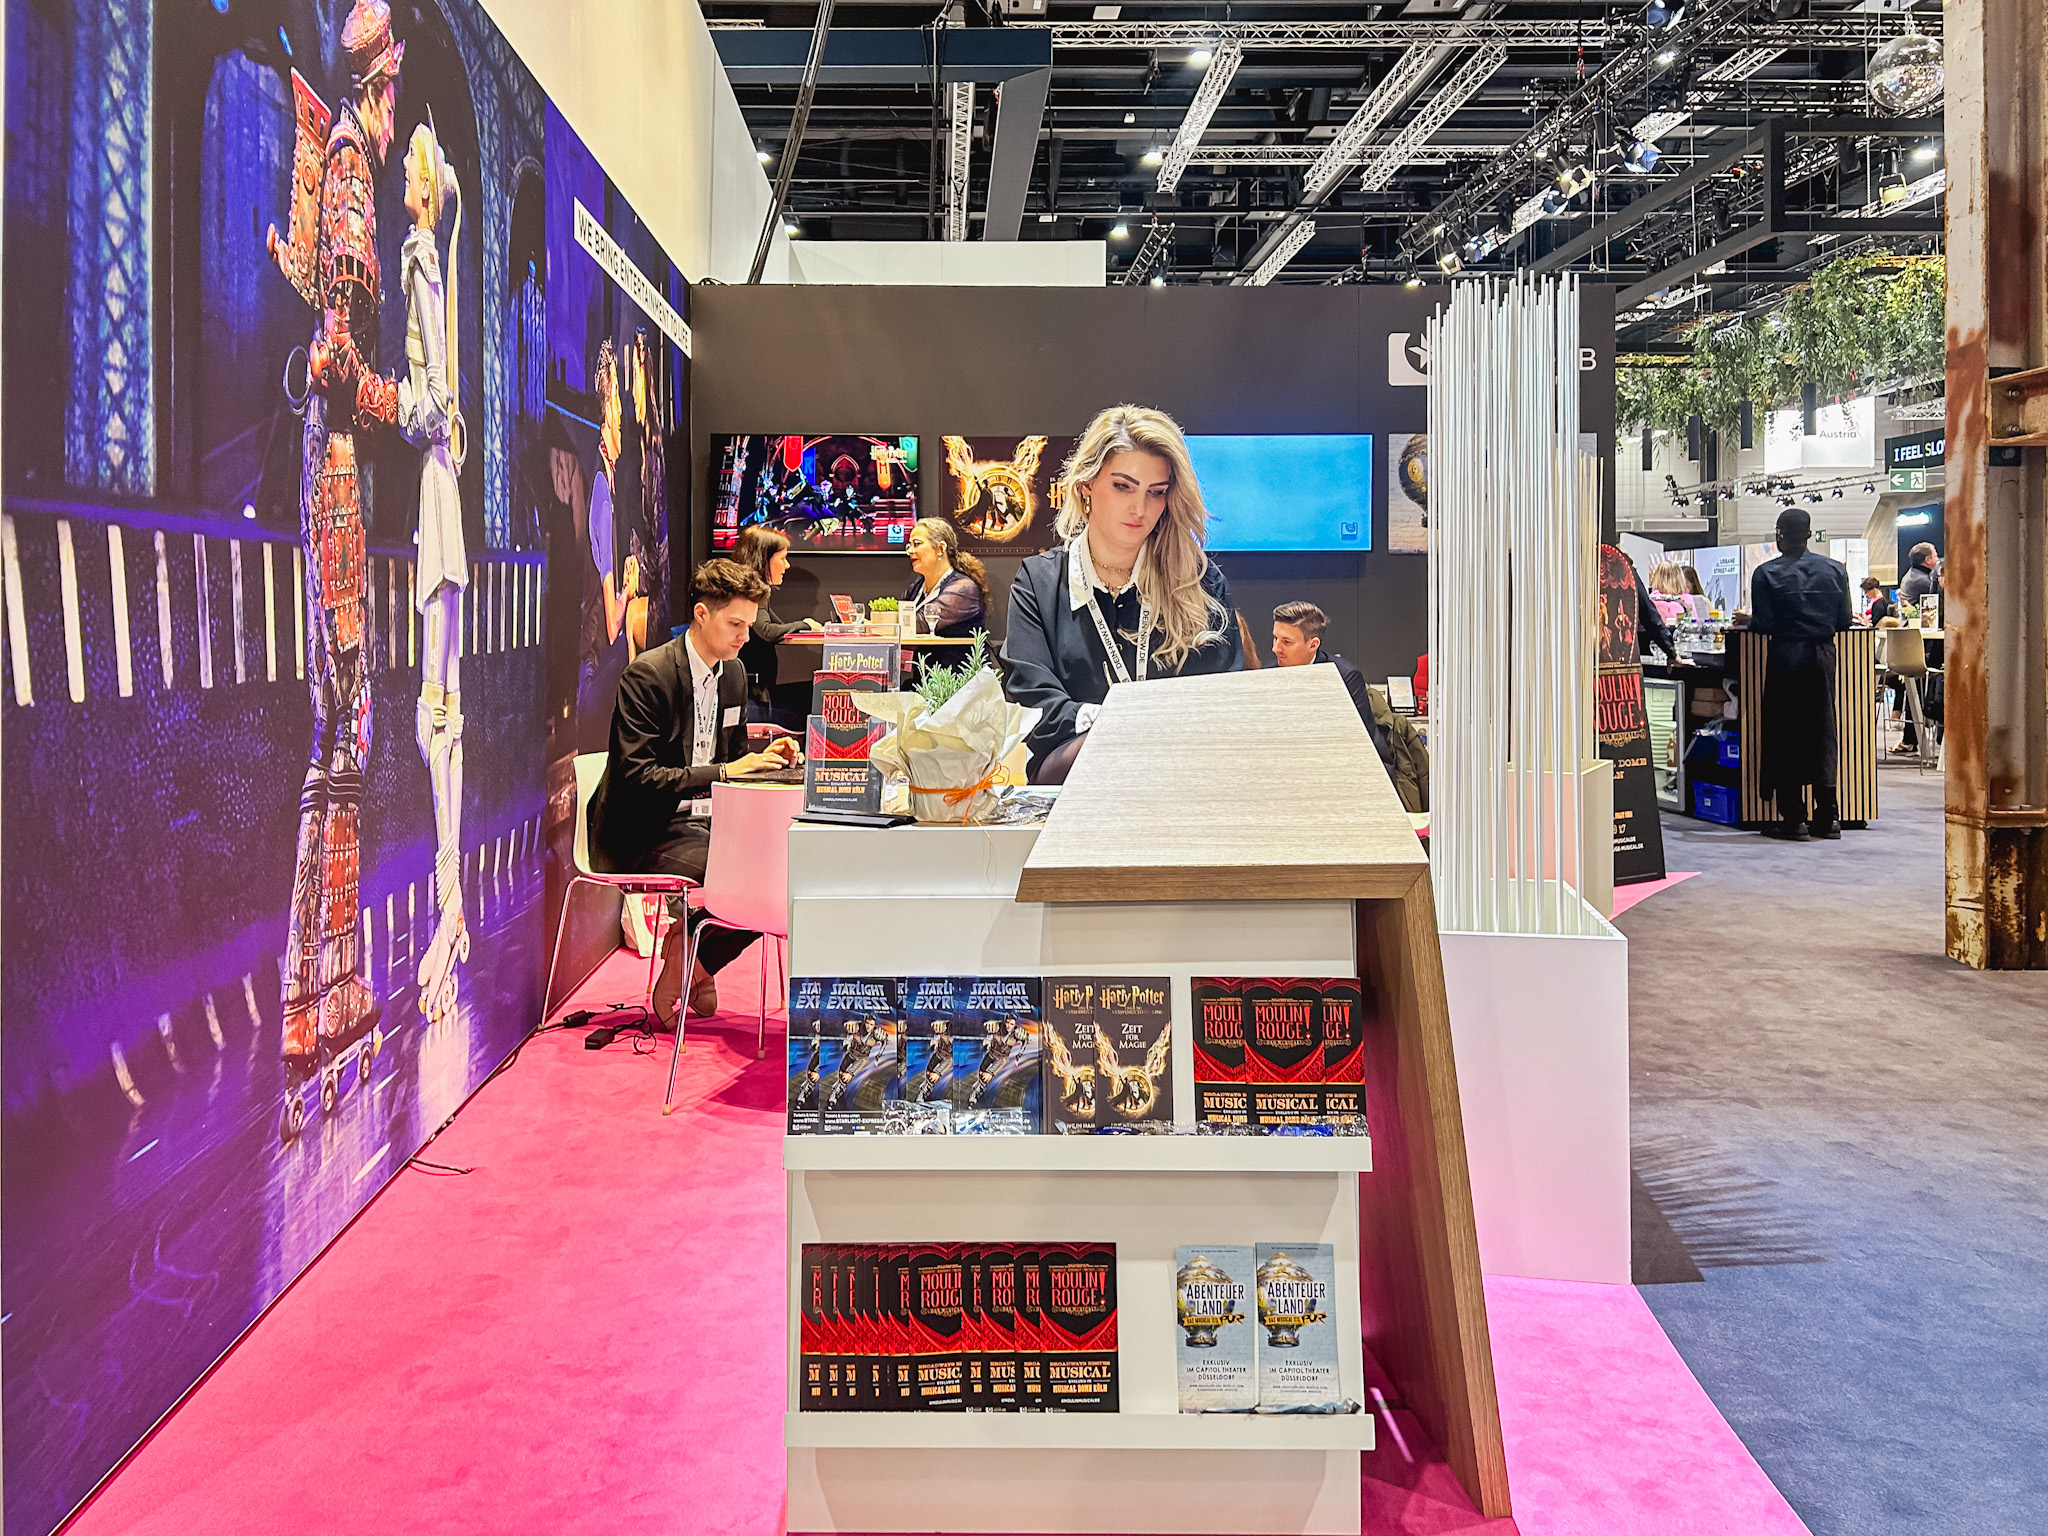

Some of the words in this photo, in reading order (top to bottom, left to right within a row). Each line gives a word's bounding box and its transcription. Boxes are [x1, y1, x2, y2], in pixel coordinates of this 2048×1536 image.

[578, 210, 593, 249] WE
[595, 229, 619, 276] BRING
[620, 258, 669, 330] ENTERTAINMENT
[670, 315, 677, 339] TO
[678, 322, 689, 350] LIFE
[1819, 430, 1857, 439] Austria
[1894, 447, 1900, 462] I
[1900, 444, 1923, 461] FEEL
[1925, 440, 1946, 456] SLO
[828, 655, 856, 671] Harry
[856, 653, 884, 671] Potter
[814, 772, 869, 781] MUSICAL
[830, 980, 884, 996] STARLIGHT
[970, 980, 1026, 995] STARLIGHT
[826, 996, 888, 1010] EXPRESS
[966, 996, 1031, 1010] EXPRESS
[1053, 987, 1084, 1010] Harry
[1099, 987, 1131, 1010] Harry
[1131, 985, 1165, 1009] Potter
[1203, 1005, 1243, 1022] MOULI
[1075, 1023, 1094, 1034] ZEIT
[1121, 1023, 1143, 1034] ZEIT
[1204, 1022, 1243, 1039] ROUG
[1072, 1040, 1094, 1049] MAGI
[1119, 1040, 1146, 1049] MAGIE
[1203, 1097, 1247, 1109] MUSIC
[1255, 1098, 1319, 1110] MUSICAL
[1326, 1098, 1358, 1110] ICAL
[1186, 1283, 1244, 1300] ABENTEUER
[1267, 1281, 1326, 1298] ABENTEUER
[1196, 1300, 1222, 1315] LAND
[1278, 1299, 1304, 1314] LAND
[918, 1367, 962, 1381] MUSIC
[1049, 1366, 1111, 1379] MUSICAL
